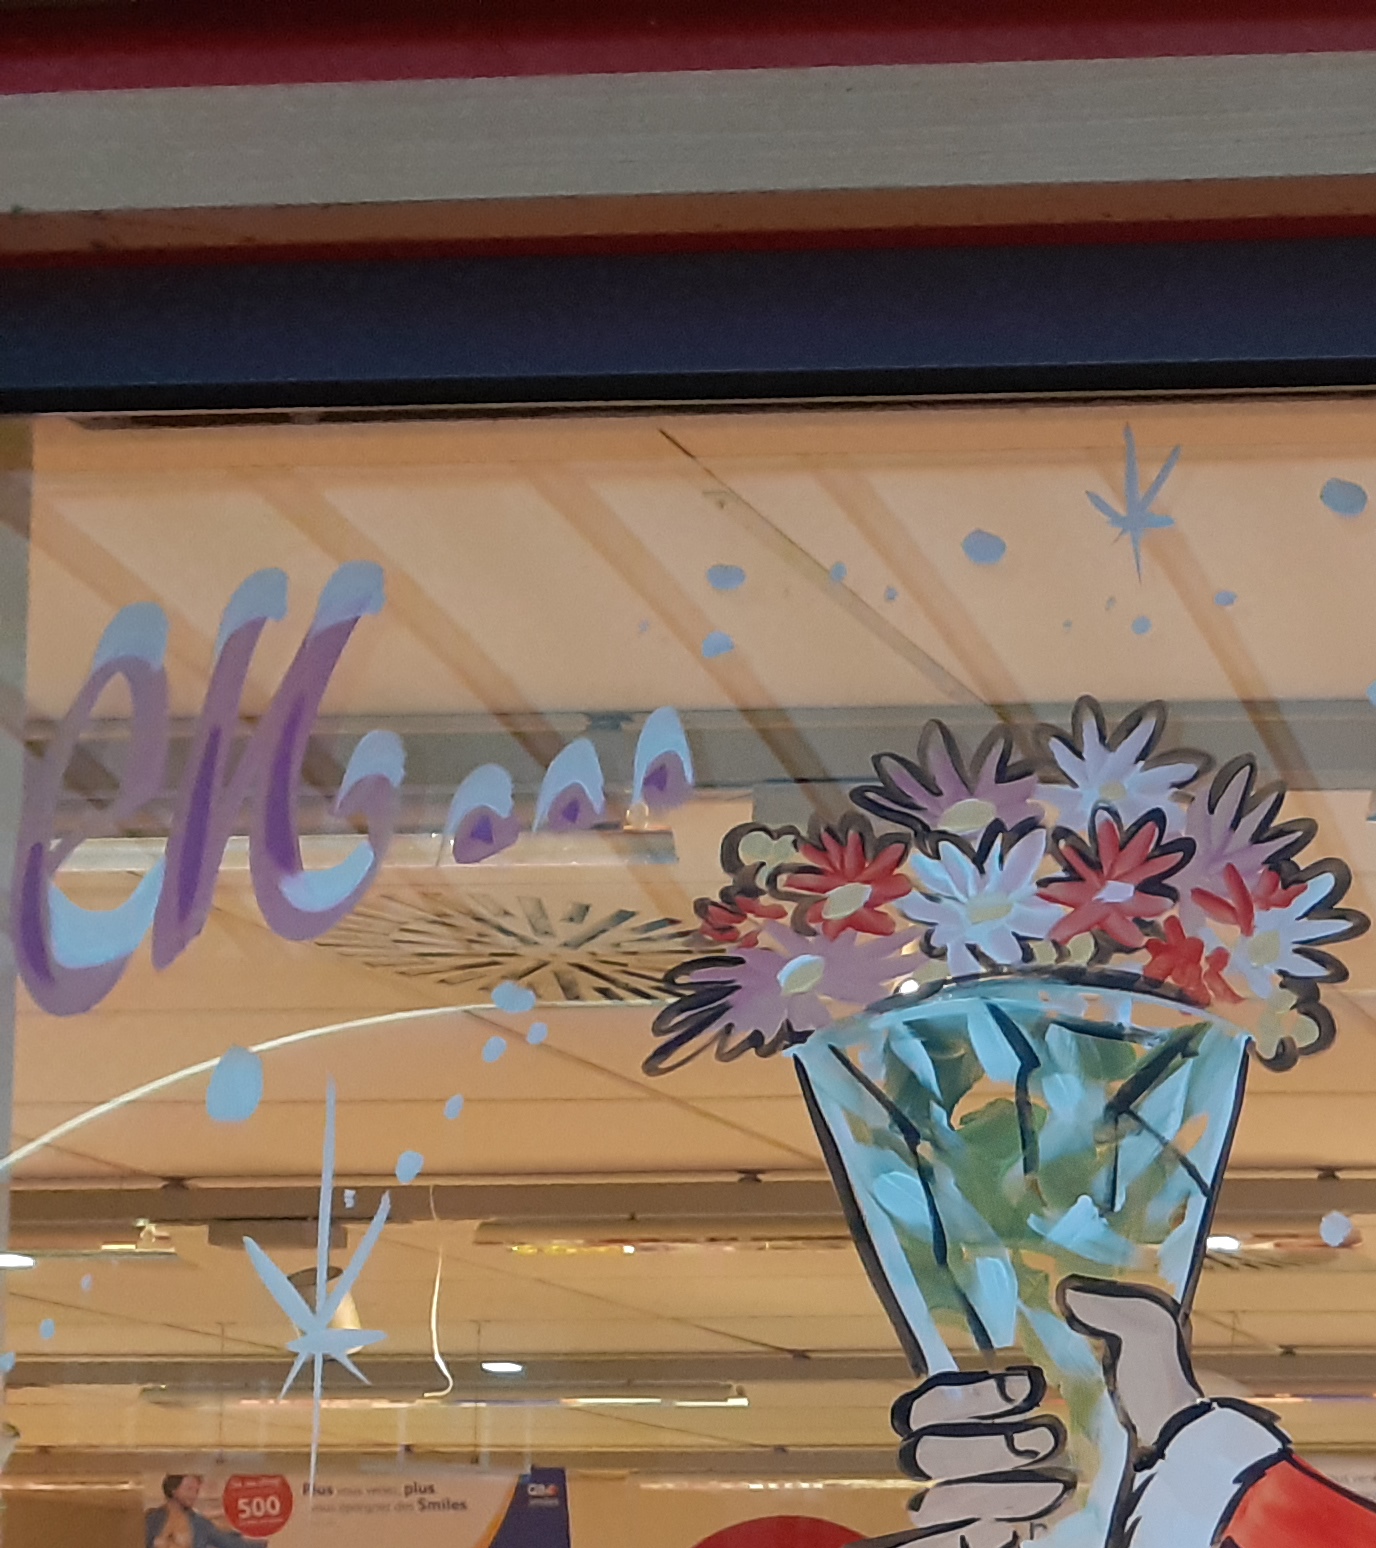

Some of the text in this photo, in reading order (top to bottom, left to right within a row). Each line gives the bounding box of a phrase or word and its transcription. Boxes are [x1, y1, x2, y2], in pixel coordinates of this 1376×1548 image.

[404, 1482, 435, 1498] plus
[237, 1496, 281, 1518] 500
[417, 1498, 468, 1512] Smiles
